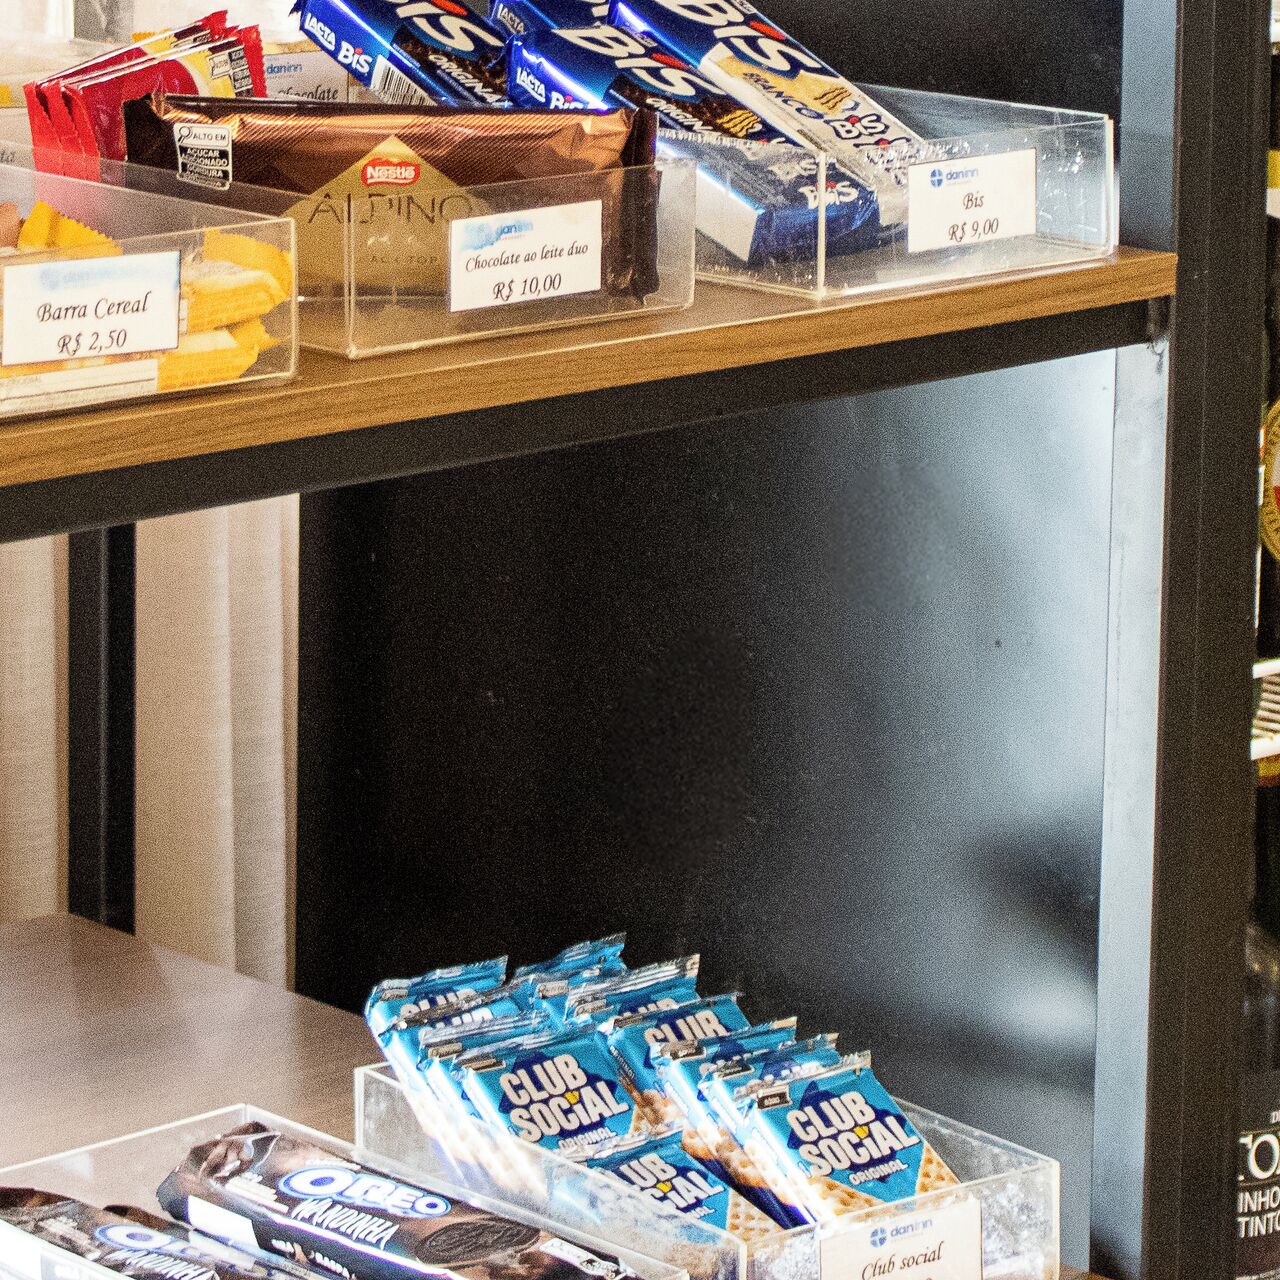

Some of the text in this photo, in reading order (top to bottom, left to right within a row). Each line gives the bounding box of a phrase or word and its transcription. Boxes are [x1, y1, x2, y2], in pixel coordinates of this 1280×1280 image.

[304, 13, 336, 51] LACTA
[266, 62, 303, 75] daninn
[516, 67, 547, 103] LACTA
[743, 72, 824, 120] BRANCO
[193, 133, 213, 141] ALTO
[945, 167, 979, 184] daninn
[962, 192, 985, 211] Bis
[948, 218, 1000, 244] R$ 9,00
[464, 240, 589, 274] Chocolate ao leite duo
[492, 272, 562, 301] R$ 10,00
[36, 290, 153, 324] Barra Cereal
[58, 328, 128, 357] R$ 2,50
[499, 1053, 587, 1106] CLUB
[786, 1091, 876, 1143] CLUB
[557, 1127, 617, 1151] ORIGINAL
[848, 1157, 909, 1186] ORIGINAL
[291, 1195, 401, 1250] WANDINHA
[890, 1221, 934, 1238] daninn
[860, 1240, 944, 1280] Club social
